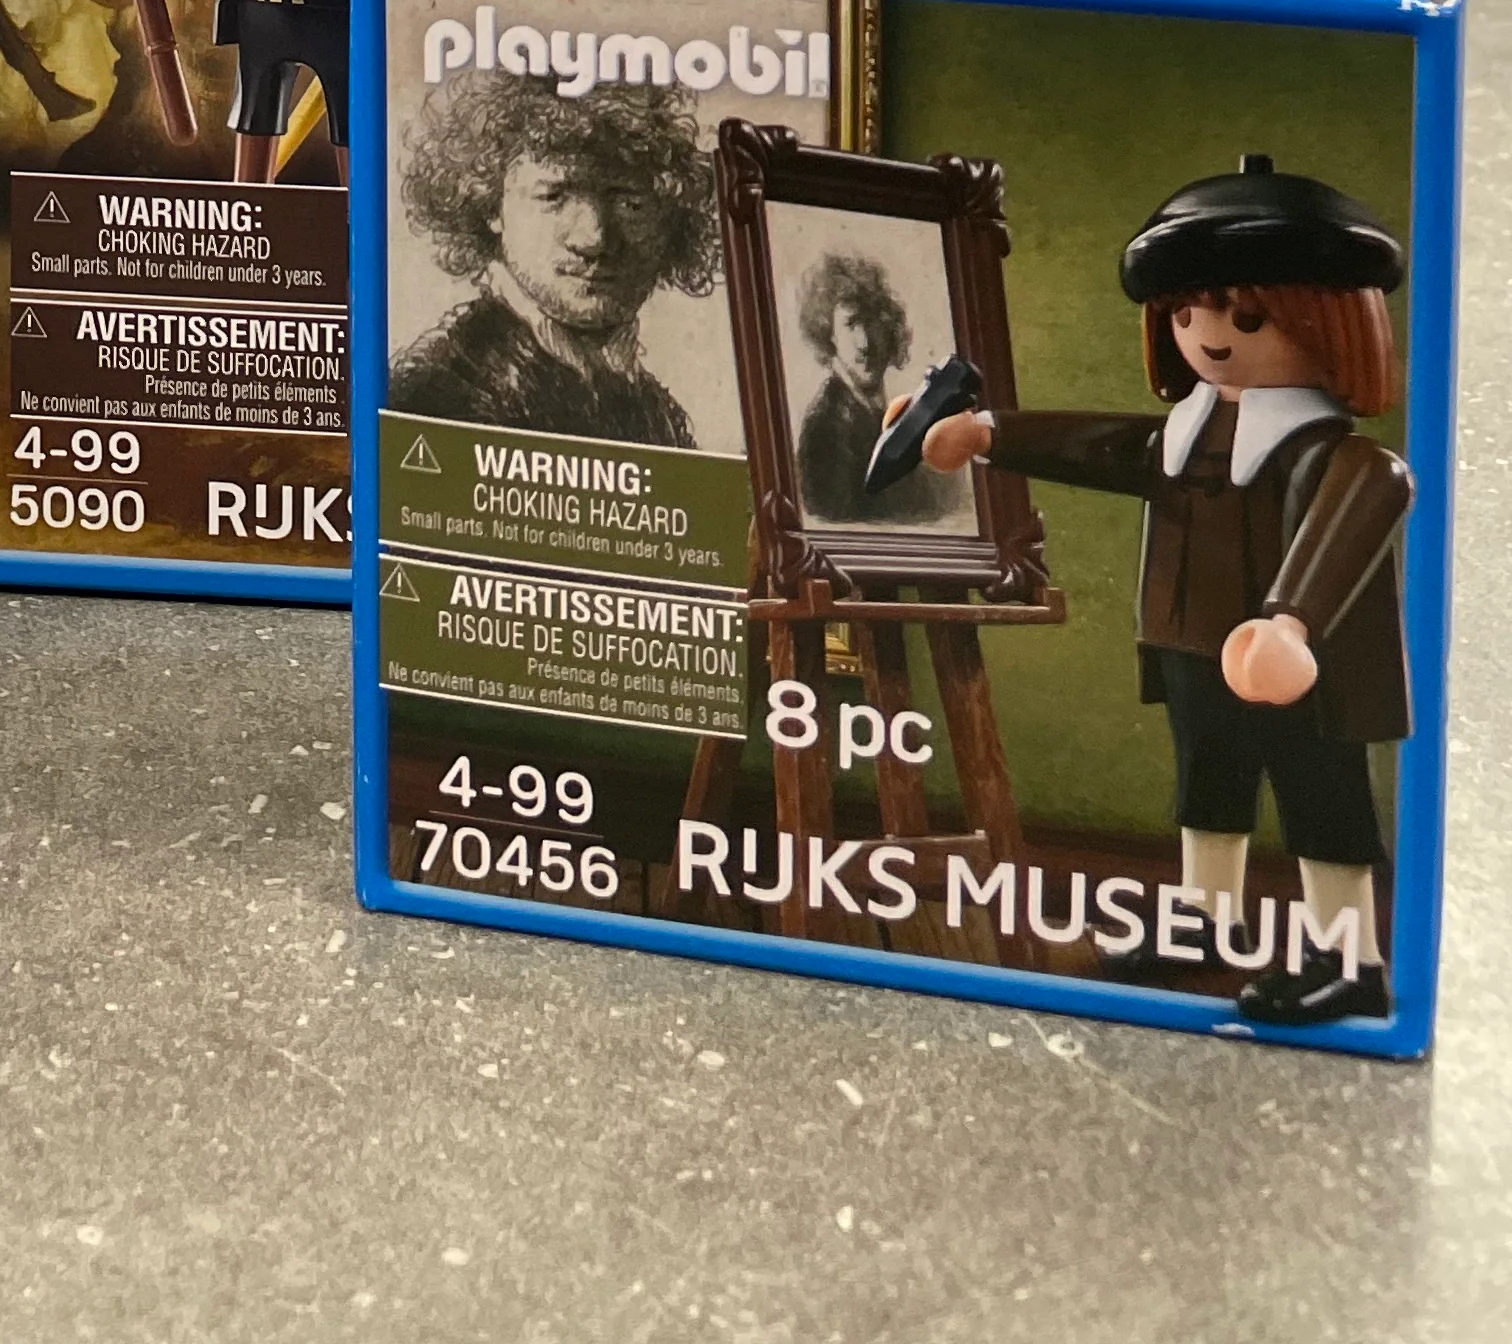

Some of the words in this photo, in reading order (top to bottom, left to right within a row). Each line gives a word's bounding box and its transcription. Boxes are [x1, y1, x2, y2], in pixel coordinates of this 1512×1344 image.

[423, 5, 831, 100] playmobil
[99, 194, 261, 232] WARNING:
[98, 228, 184, 255] CHOKING
[192, 233, 270, 259] HAZARD
[31, 252, 68, 273] Small
[74, 255, 111, 278] parts.
[117, 257, 140, 276] Not
[145, 258, 163, 278] for
[168, 259, 223, 281] children
[228, 263, 267, 283] under
[272, 265, 280, 284] 3
[285, 268, 326, 291] years.
[76, 310, 344, 353] AVERTISSEMENT:
[98, 346, 169, 372] RISQUE
[177, 350, 200, 373] DE
[207, 351, 344, 381] SUFFOCATION.
[145, 374, 206, 396] Présence
[212, 378, 227, 397] de
[232, 380, 269, 402] petits
[20, 390, 38, 409] Ne
[42, 392, 100, 413] convient
[104, 399, 127, 419] pas
[132, 401, 155, 416] aux
[160, 398, 211, 419] enfants
[215, 402, 231, 421] de
[236, 403, 278, 423] moins
[283, 406, 298, 424] de
[303, 407, 311, 425] 3
[316, 410, 344, 426] ans.
[14, 426, 140, 475] 4-99
[474, 442, 651, 498] WARNING:
[10, 483, 145, 533] 5090
[207, 481, 352, 543] RIJK
[401, 506, 441, 530] Small
[493, 519, 519, 541] Not
[524, 523, 543, 545] for
[549, 526, 609, 554] children
[615, 535, 658, 560] under
[664, 541, 673, 561] 3
[473, 482, 580, 525] CHOKING
[590, 497, 687, 538] HAZARD
[450, 572, 743, 644] AVERTISSEMENT:
[438, 610, 524, 650] RISQUE
[533, 623, 563, 655] DE
[572, 628, 743, 680] SUFFOCATION.
[388, 661, 407, 681] Ne
[412, 665, 473, 692] convient
[478, 678, 503, 700] pas
[509, 683, 534, 702] aux
[540, 683, 593, 710] enfants
[600, 692, 618, 713] de
[623, 695, 669, 720] moins
[675, 702, 693, 723] de
[698, 705, 706, 724] 3
[527, 657, 595, 684] Présence
[600, 667, 617, 687] de
[623, 670, 664, 697] petits
[765, 679, 819, 749] 8
[839, 702, 933, 769] pc
[438, 755, 595, 824] 4-99
[415, 819, 619, 898] 70456
[678, 818, 916, 920] RIJKS
[946, 853, 1361, 982] MUSEUM
